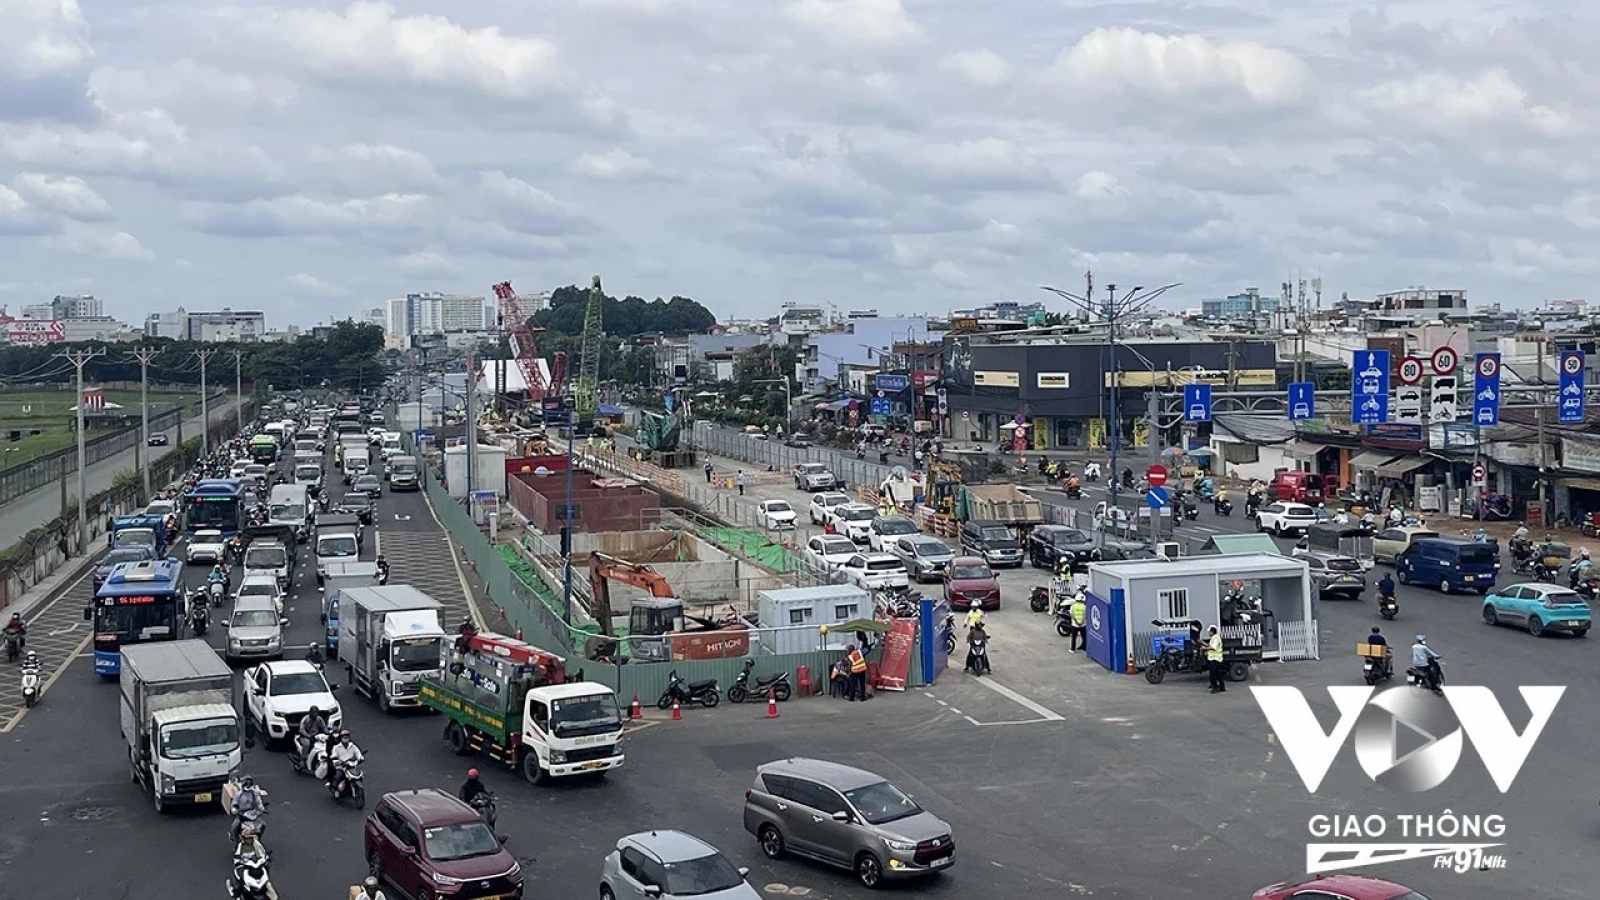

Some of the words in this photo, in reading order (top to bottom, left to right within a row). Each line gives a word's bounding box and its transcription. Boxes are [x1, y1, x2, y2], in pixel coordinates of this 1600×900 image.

[1438, 355, 1450, 367] 60
[1483, 362, 1493, 372] 50
[1568, 359, 1578, 370] 50
[1404, 364, 1416, 376] 80
[706, 638, 742, 652] HITACHI
